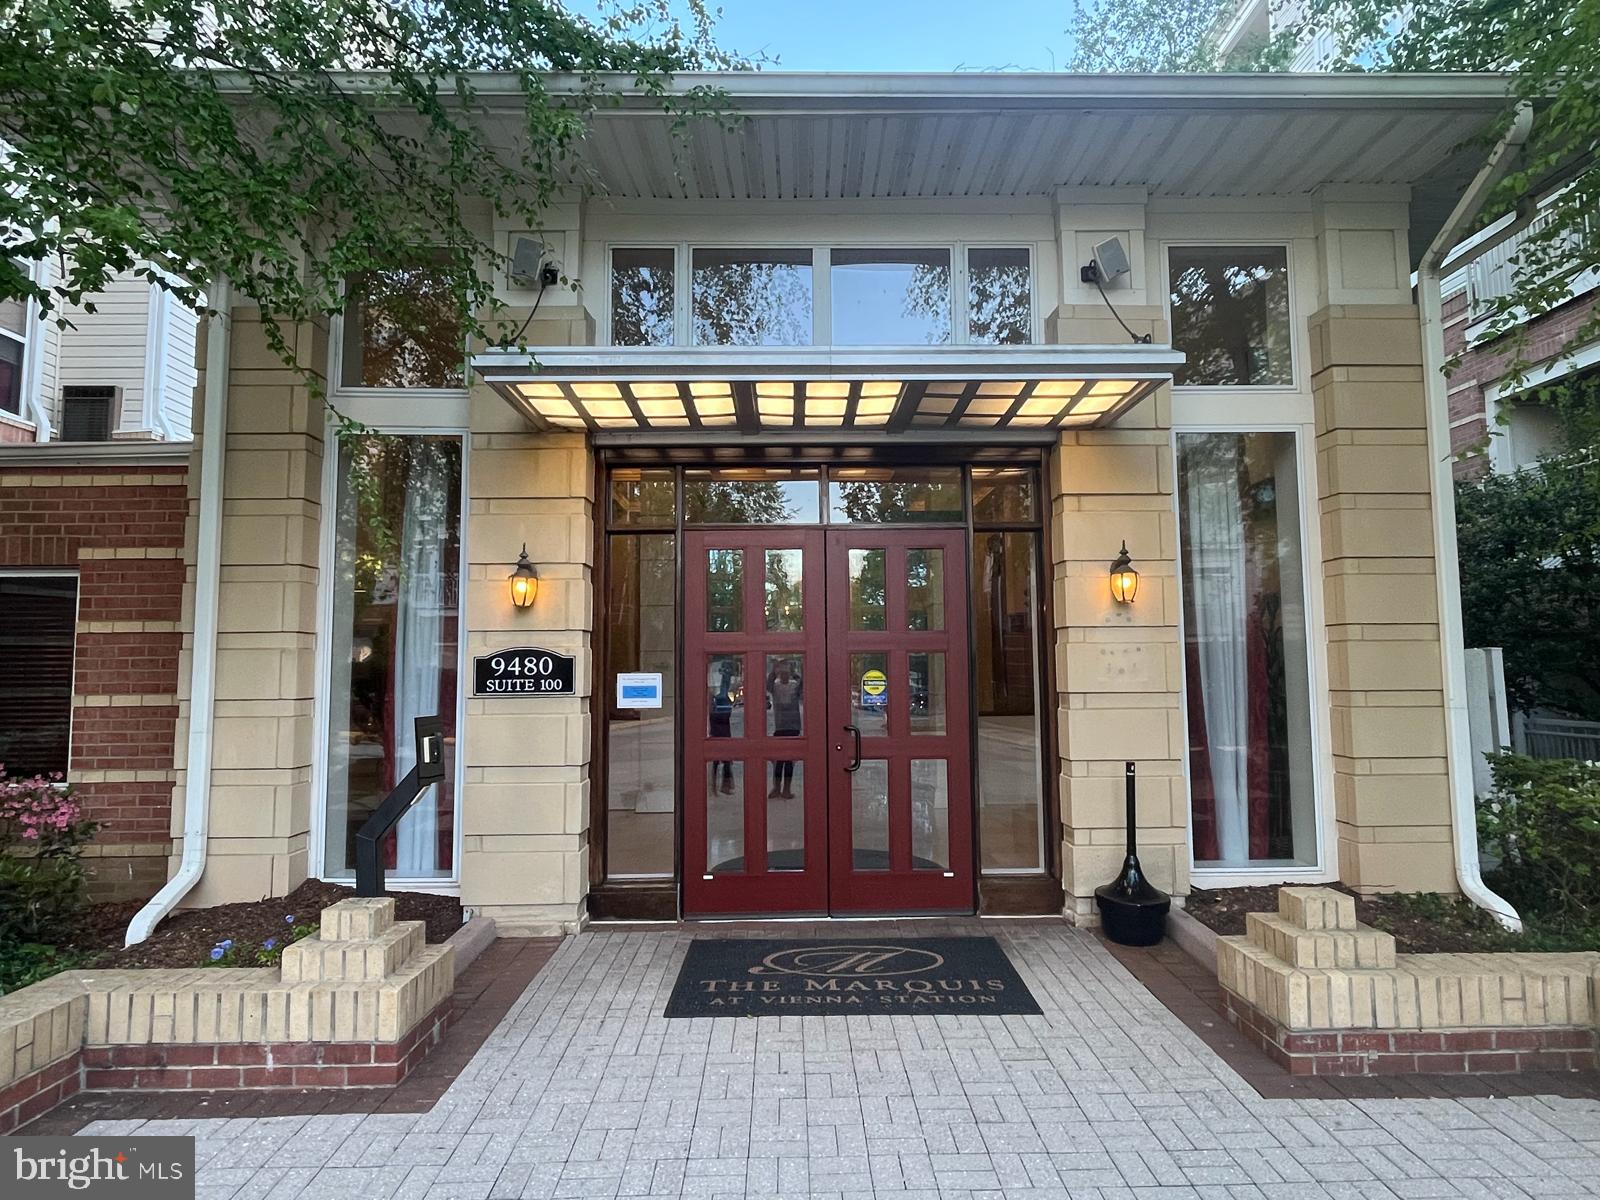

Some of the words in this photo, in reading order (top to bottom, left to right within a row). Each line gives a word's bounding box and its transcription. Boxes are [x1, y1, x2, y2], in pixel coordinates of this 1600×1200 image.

[491, 656, 553, 677] 9480
[486, 679, 535, 692] SUITE
[540, 678, 563, 691] 100
[699, 979, 781, 992] THE
[804, 978, 1005, 994] MARQUIS
[710, 996, 745, 1006] AT
[760, 995, 862, 1004] VIENNA
[880, 995, 997, 1004] STATION
